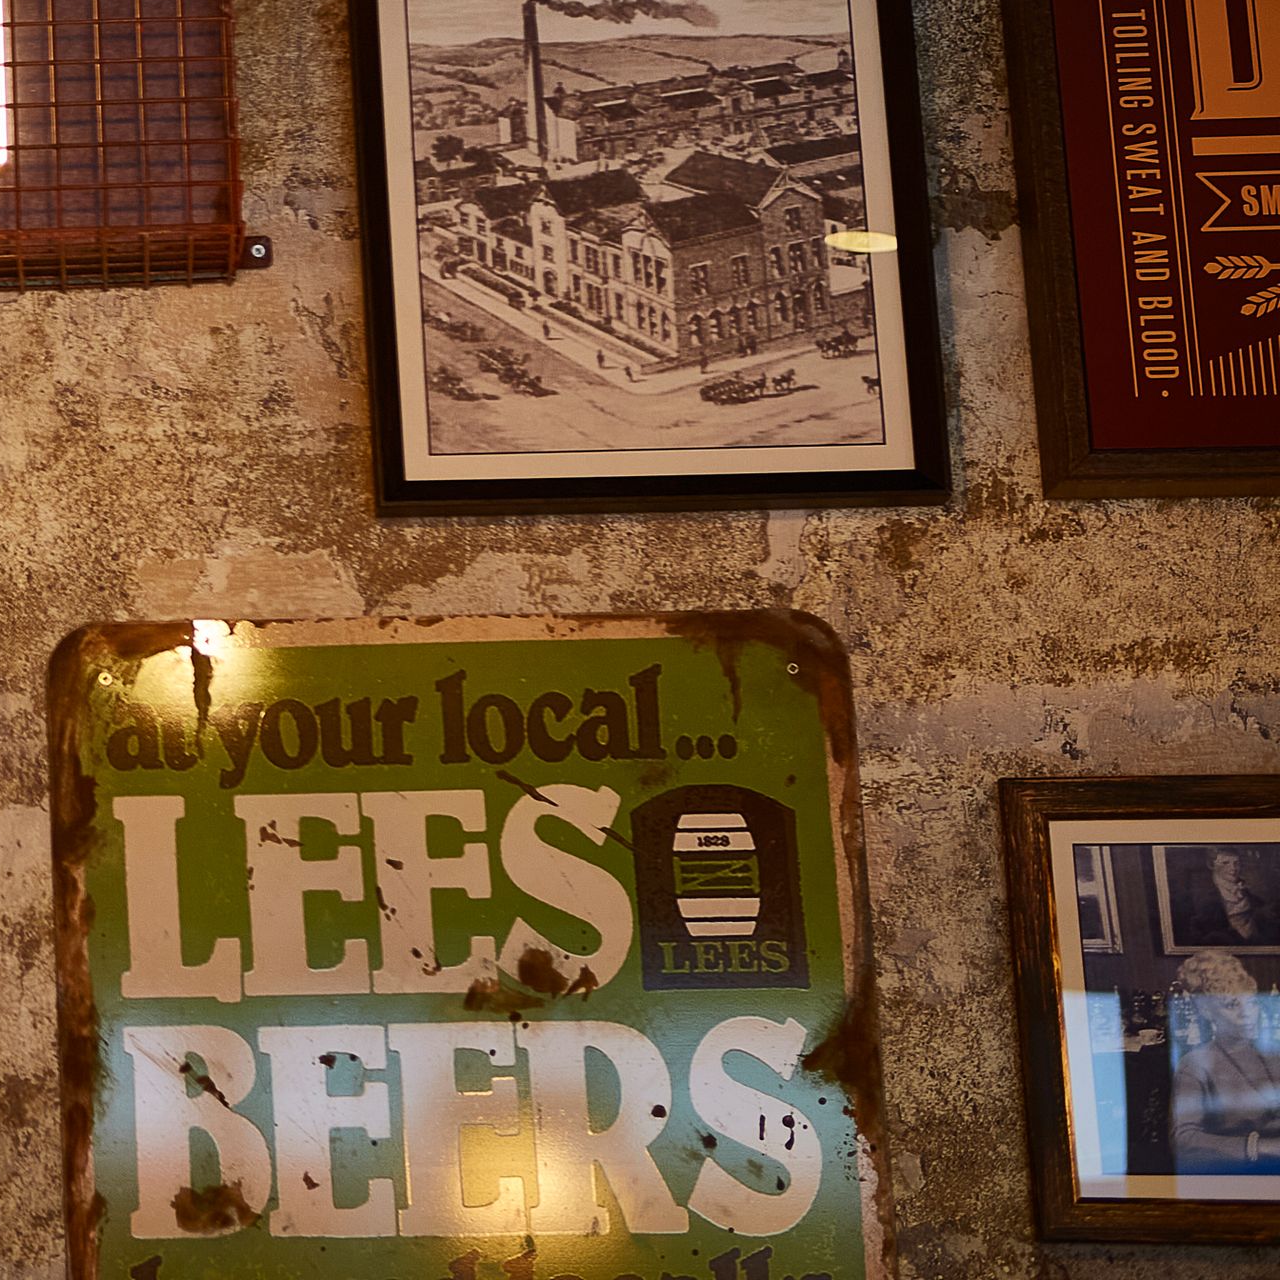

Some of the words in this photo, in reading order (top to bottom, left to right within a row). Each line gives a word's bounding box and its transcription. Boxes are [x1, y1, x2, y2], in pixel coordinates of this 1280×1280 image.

[1112, 10, 1154, 110] TOILING
[1122, 121, 1165, 217] SWEAT
[1132, 230, 1172, 282] AND
[1138, 294, 1181, 380] BLOOD
[205, 692, 419, 788] your
[697, 835, 730, 848] 1828
[112, 783, 635, 1004] LEES
[657, 940, 790, 974] LEES
[123, 1016, 823, 1239] BEERS
